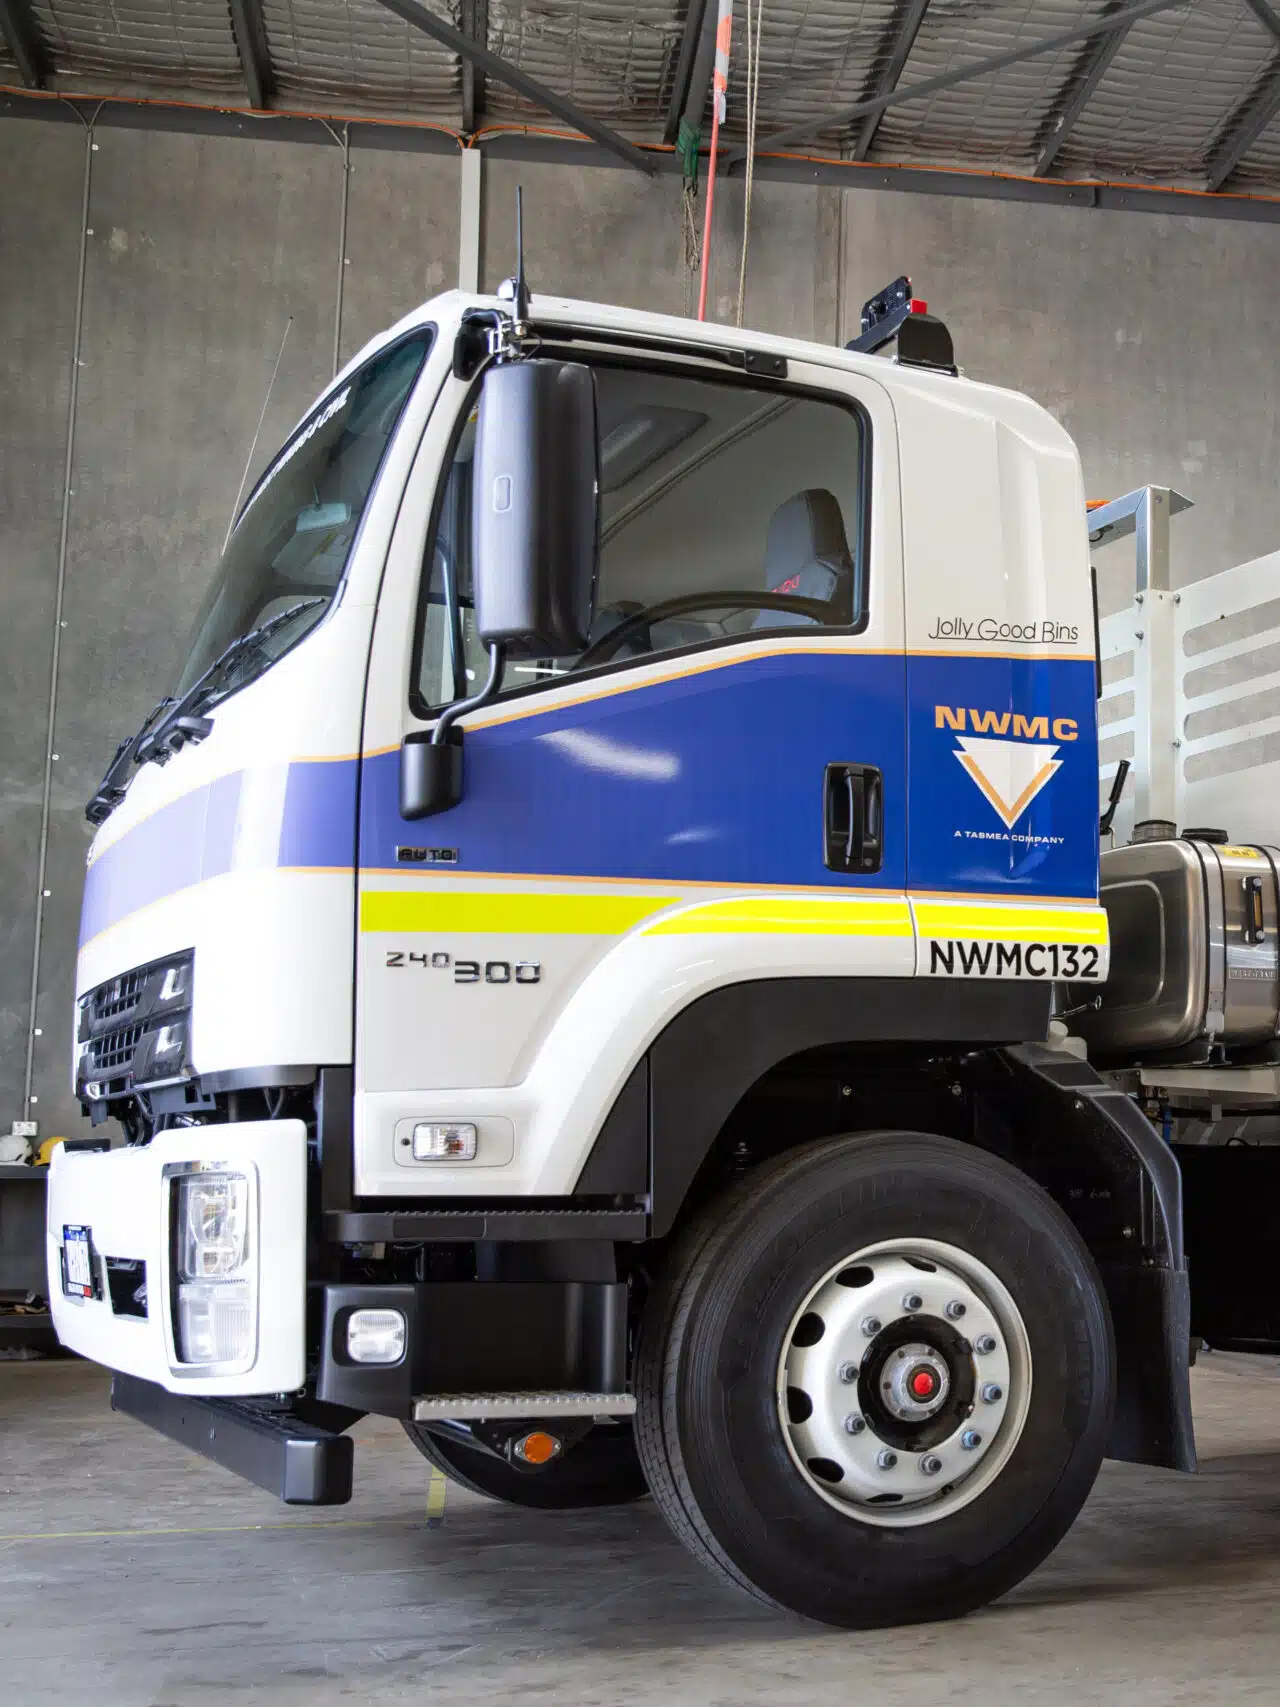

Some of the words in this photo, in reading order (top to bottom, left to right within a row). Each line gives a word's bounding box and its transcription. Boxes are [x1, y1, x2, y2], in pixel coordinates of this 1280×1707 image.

[928, 617, 973, 639] Jolly
[978, 618, 1036, 640] Good
[1042, 622, 1078, 643] Bins
[935, 705, 1078, 741] NWMC
[954, 830, 962, 838] A
[965, 831, 1009, 840] TASMEA
[1011, 834, 1064, 844] COMPANY
[386, 951, 450, 968] 240
[454, 961, 541, 983] 300
[930, 940, 1099, 978] NWMC132
